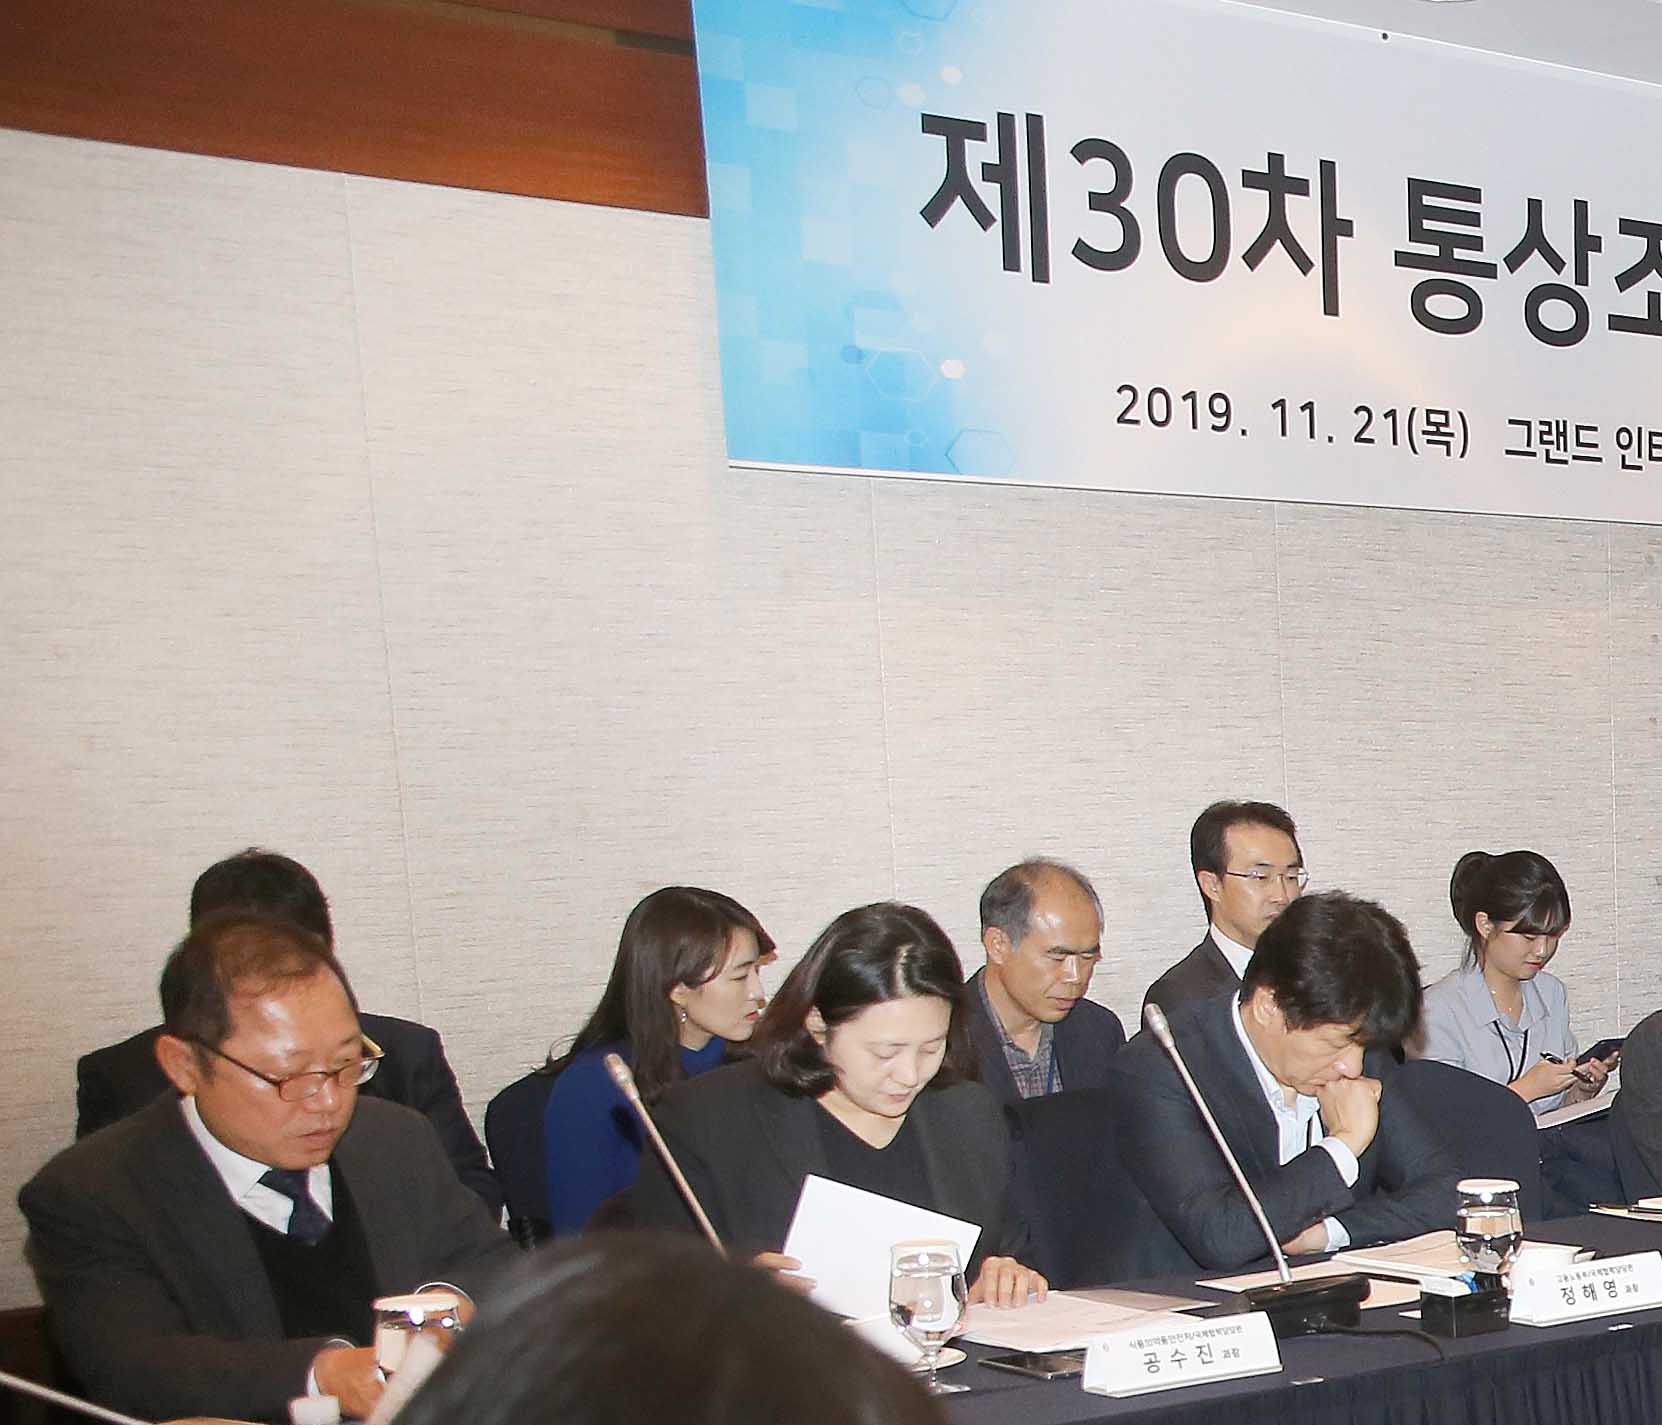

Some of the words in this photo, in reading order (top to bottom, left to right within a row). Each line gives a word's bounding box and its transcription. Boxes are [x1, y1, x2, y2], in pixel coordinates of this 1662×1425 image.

[919, 111, 1355, 317] 제30차
[1115, 383, 1248, 437] 2019.
[1272, 398, 1336, 445] 11.
[1353, 405, 1470, 461] 21(목)
[1504, 417, 1603, 467] 그랜드
[1560, 1279, 1619, 1306] 정해영
[1143, 1342, 1216, 1374] 공수진
